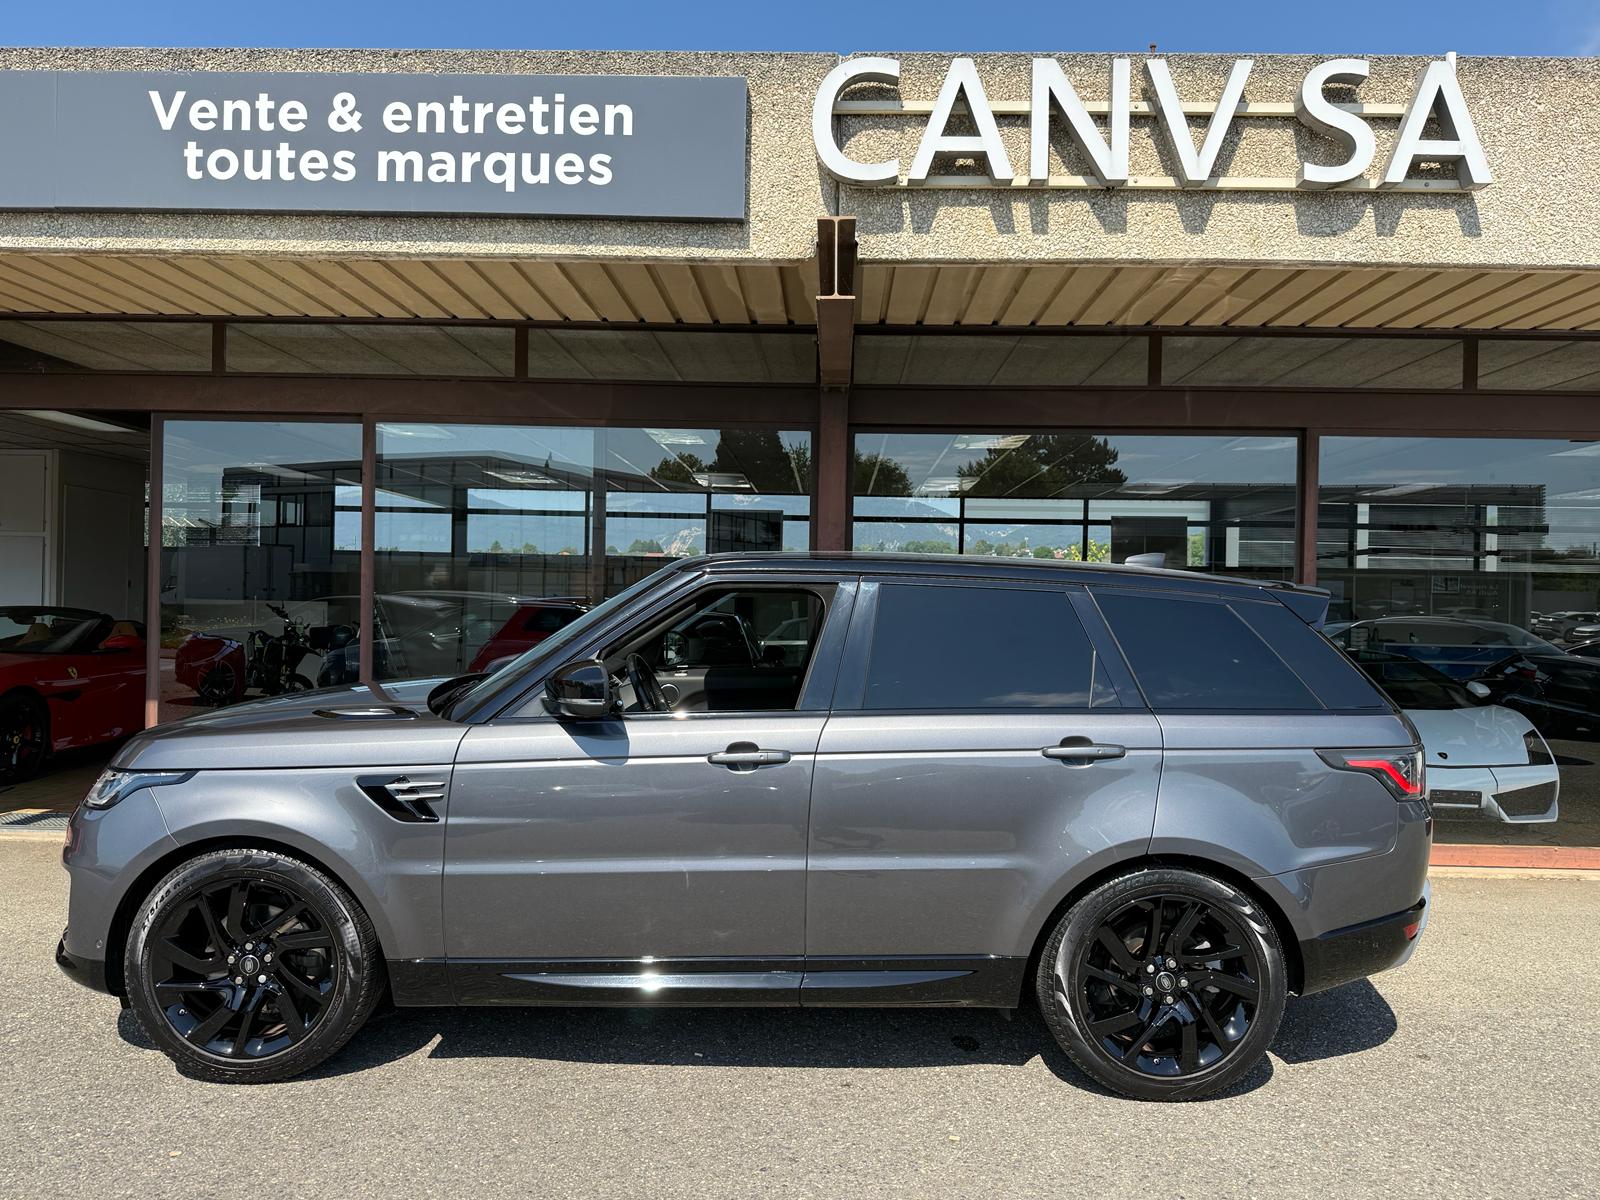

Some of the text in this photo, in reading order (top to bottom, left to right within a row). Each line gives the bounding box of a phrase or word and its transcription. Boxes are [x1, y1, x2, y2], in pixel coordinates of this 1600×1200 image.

[148, 90, 633, 136] Vente & entretien
[812, 53, 1494, 190] CANV SA
[183, 141, 613, 193] toutes marques
